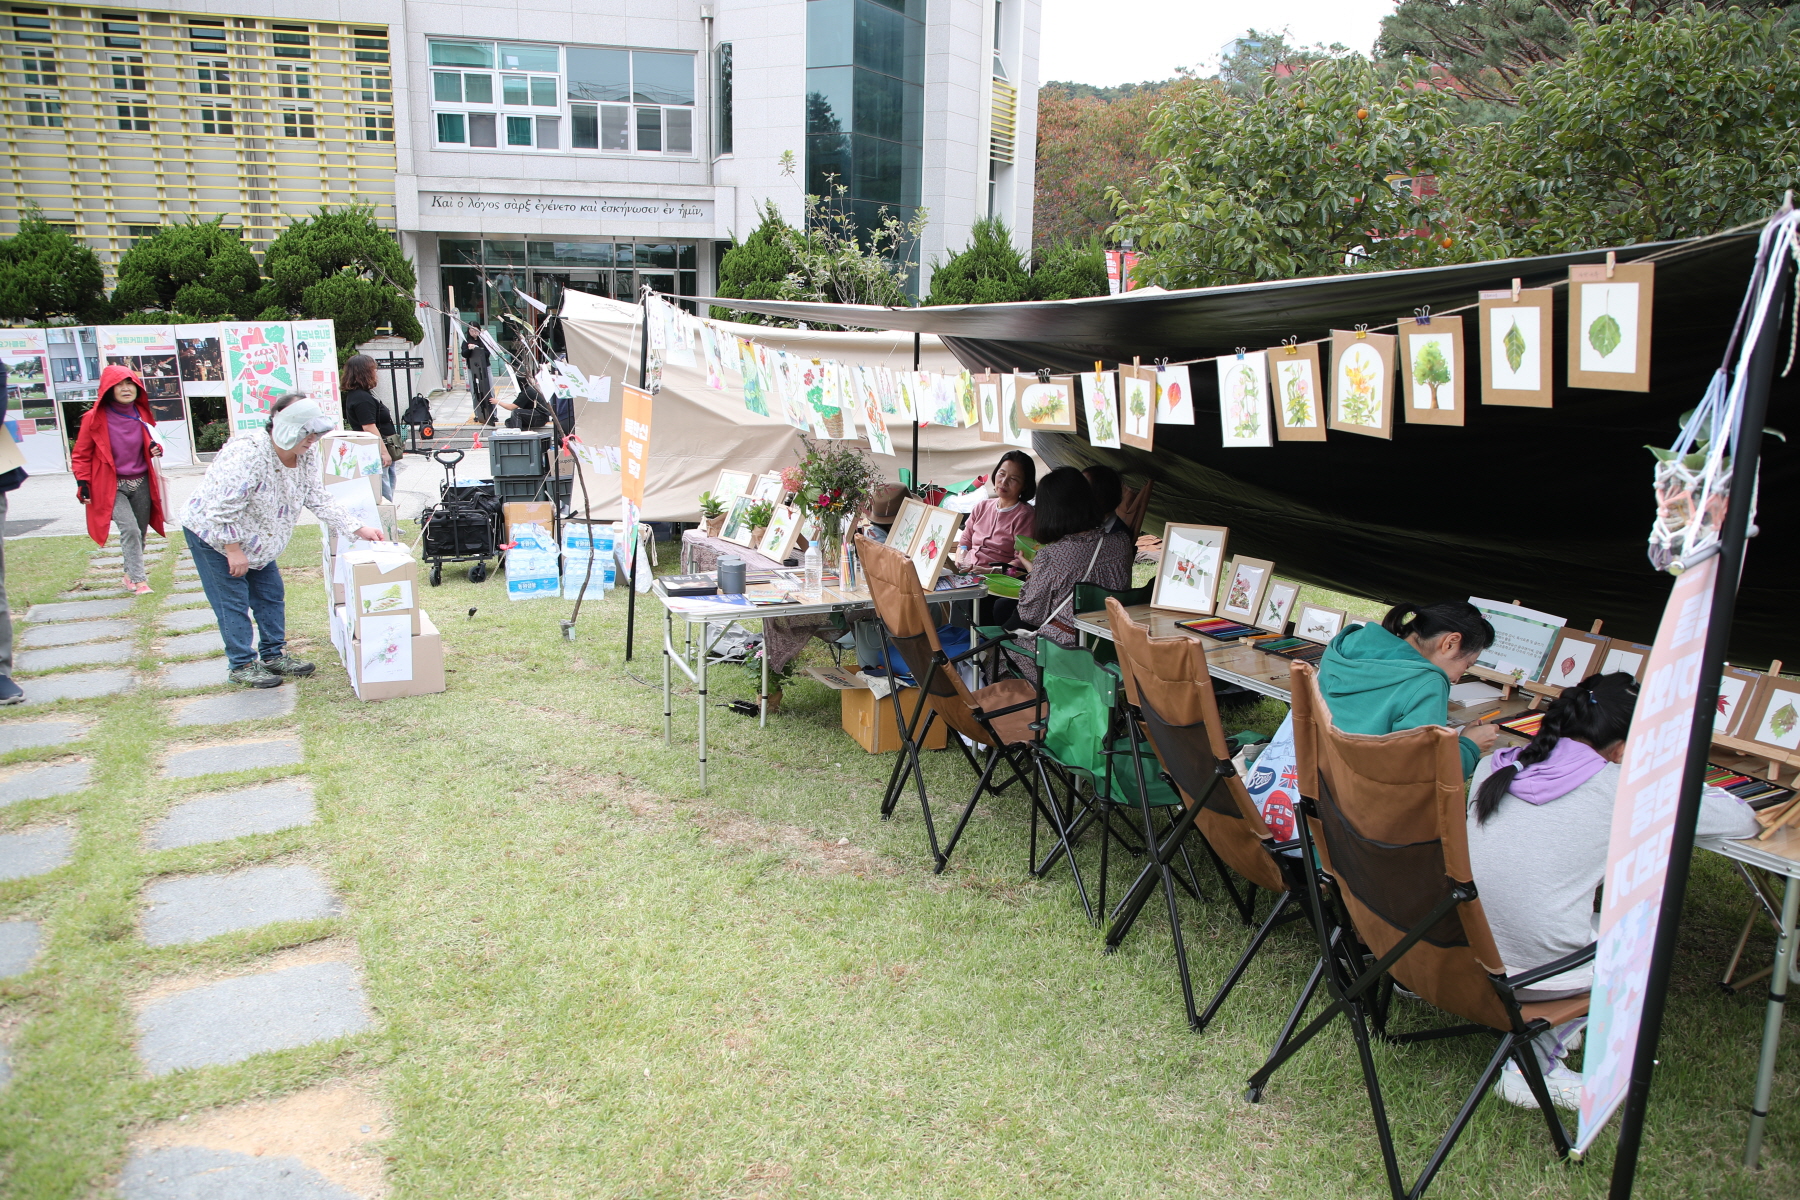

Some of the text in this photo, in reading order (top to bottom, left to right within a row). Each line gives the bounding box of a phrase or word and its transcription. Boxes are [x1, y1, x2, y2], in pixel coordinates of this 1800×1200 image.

[431, 195, 453, 208] Καὶ
[468, 196, 500, 212] λόγος
[504, 198, 531, 213] σὰρξ
[534, 199, 576, 214] ἐγένετο
[580, 200, 598, 212] καὶ
